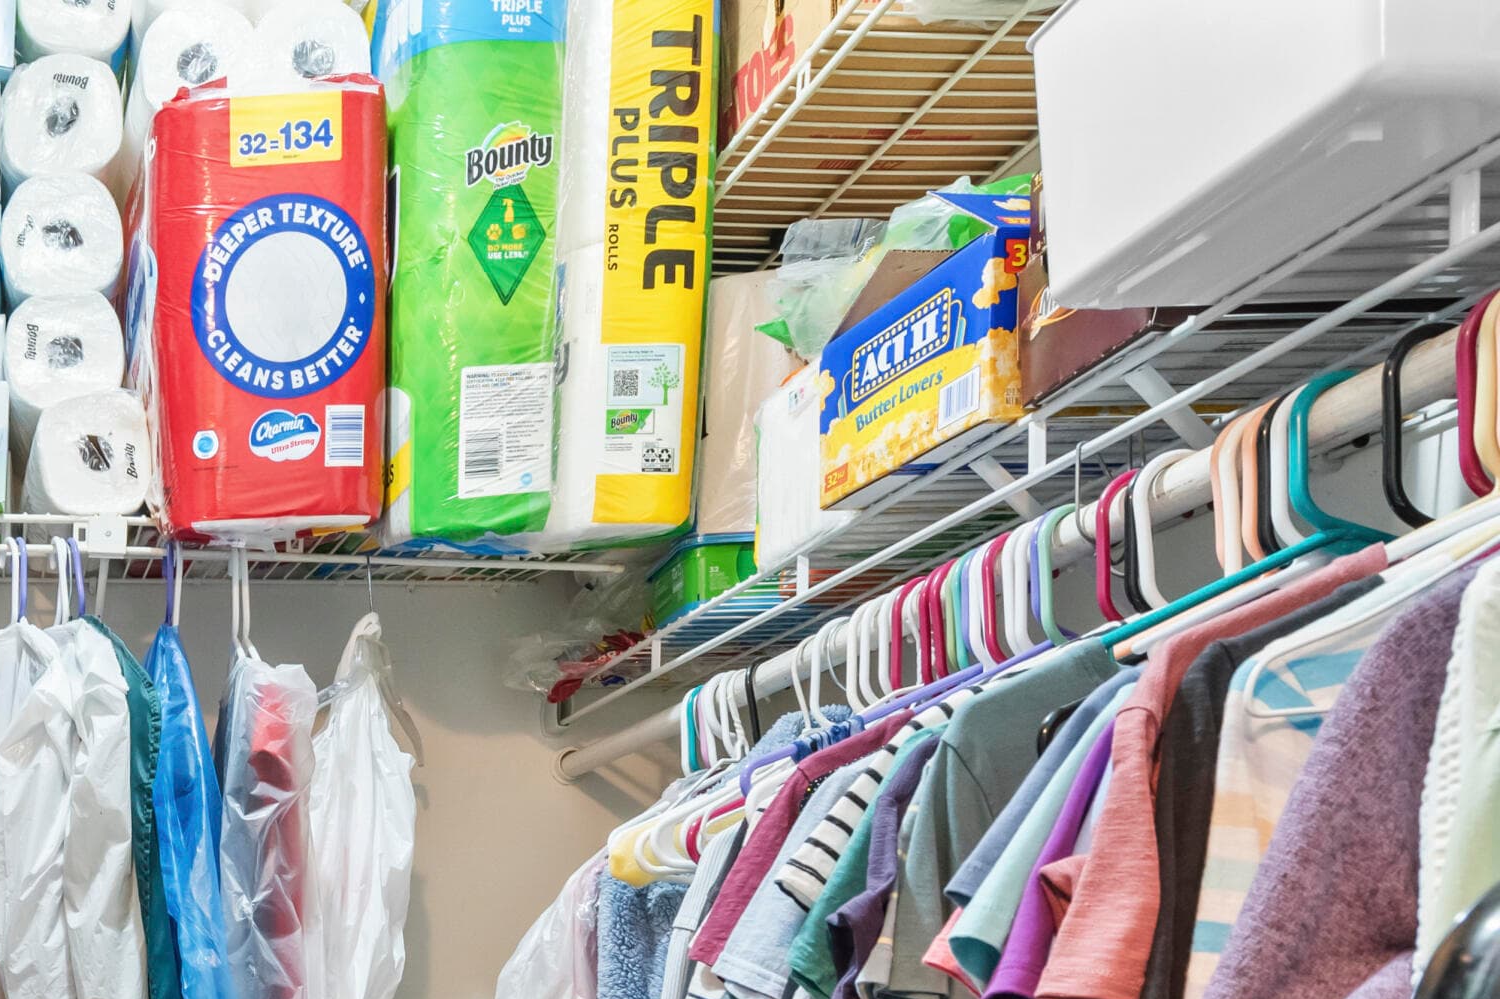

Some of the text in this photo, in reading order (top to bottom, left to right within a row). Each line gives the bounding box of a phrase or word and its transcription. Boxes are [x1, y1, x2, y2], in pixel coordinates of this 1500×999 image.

[502, 14, 531, 26] PLUS
[466, 133, 553, 186] Bounty
[642, 14, 703, 290] TRIPLE
[607, 107, 641, 271] PLUS ROLLS
[202, 202, 366, 283] DEEPER TEXTURE
[1011, 243, 1027, 267] 3
[207, 324, 364, 391] CLEANS BETTER
[861, 308, 940, 386] ACT II
[611, 413, 638, 428] Bounty
[855, 369, 944, 432] Butter Lovers
[256, 418, 305, 442] Charmin
[270, 436, 315, 454] Ultra Strong
